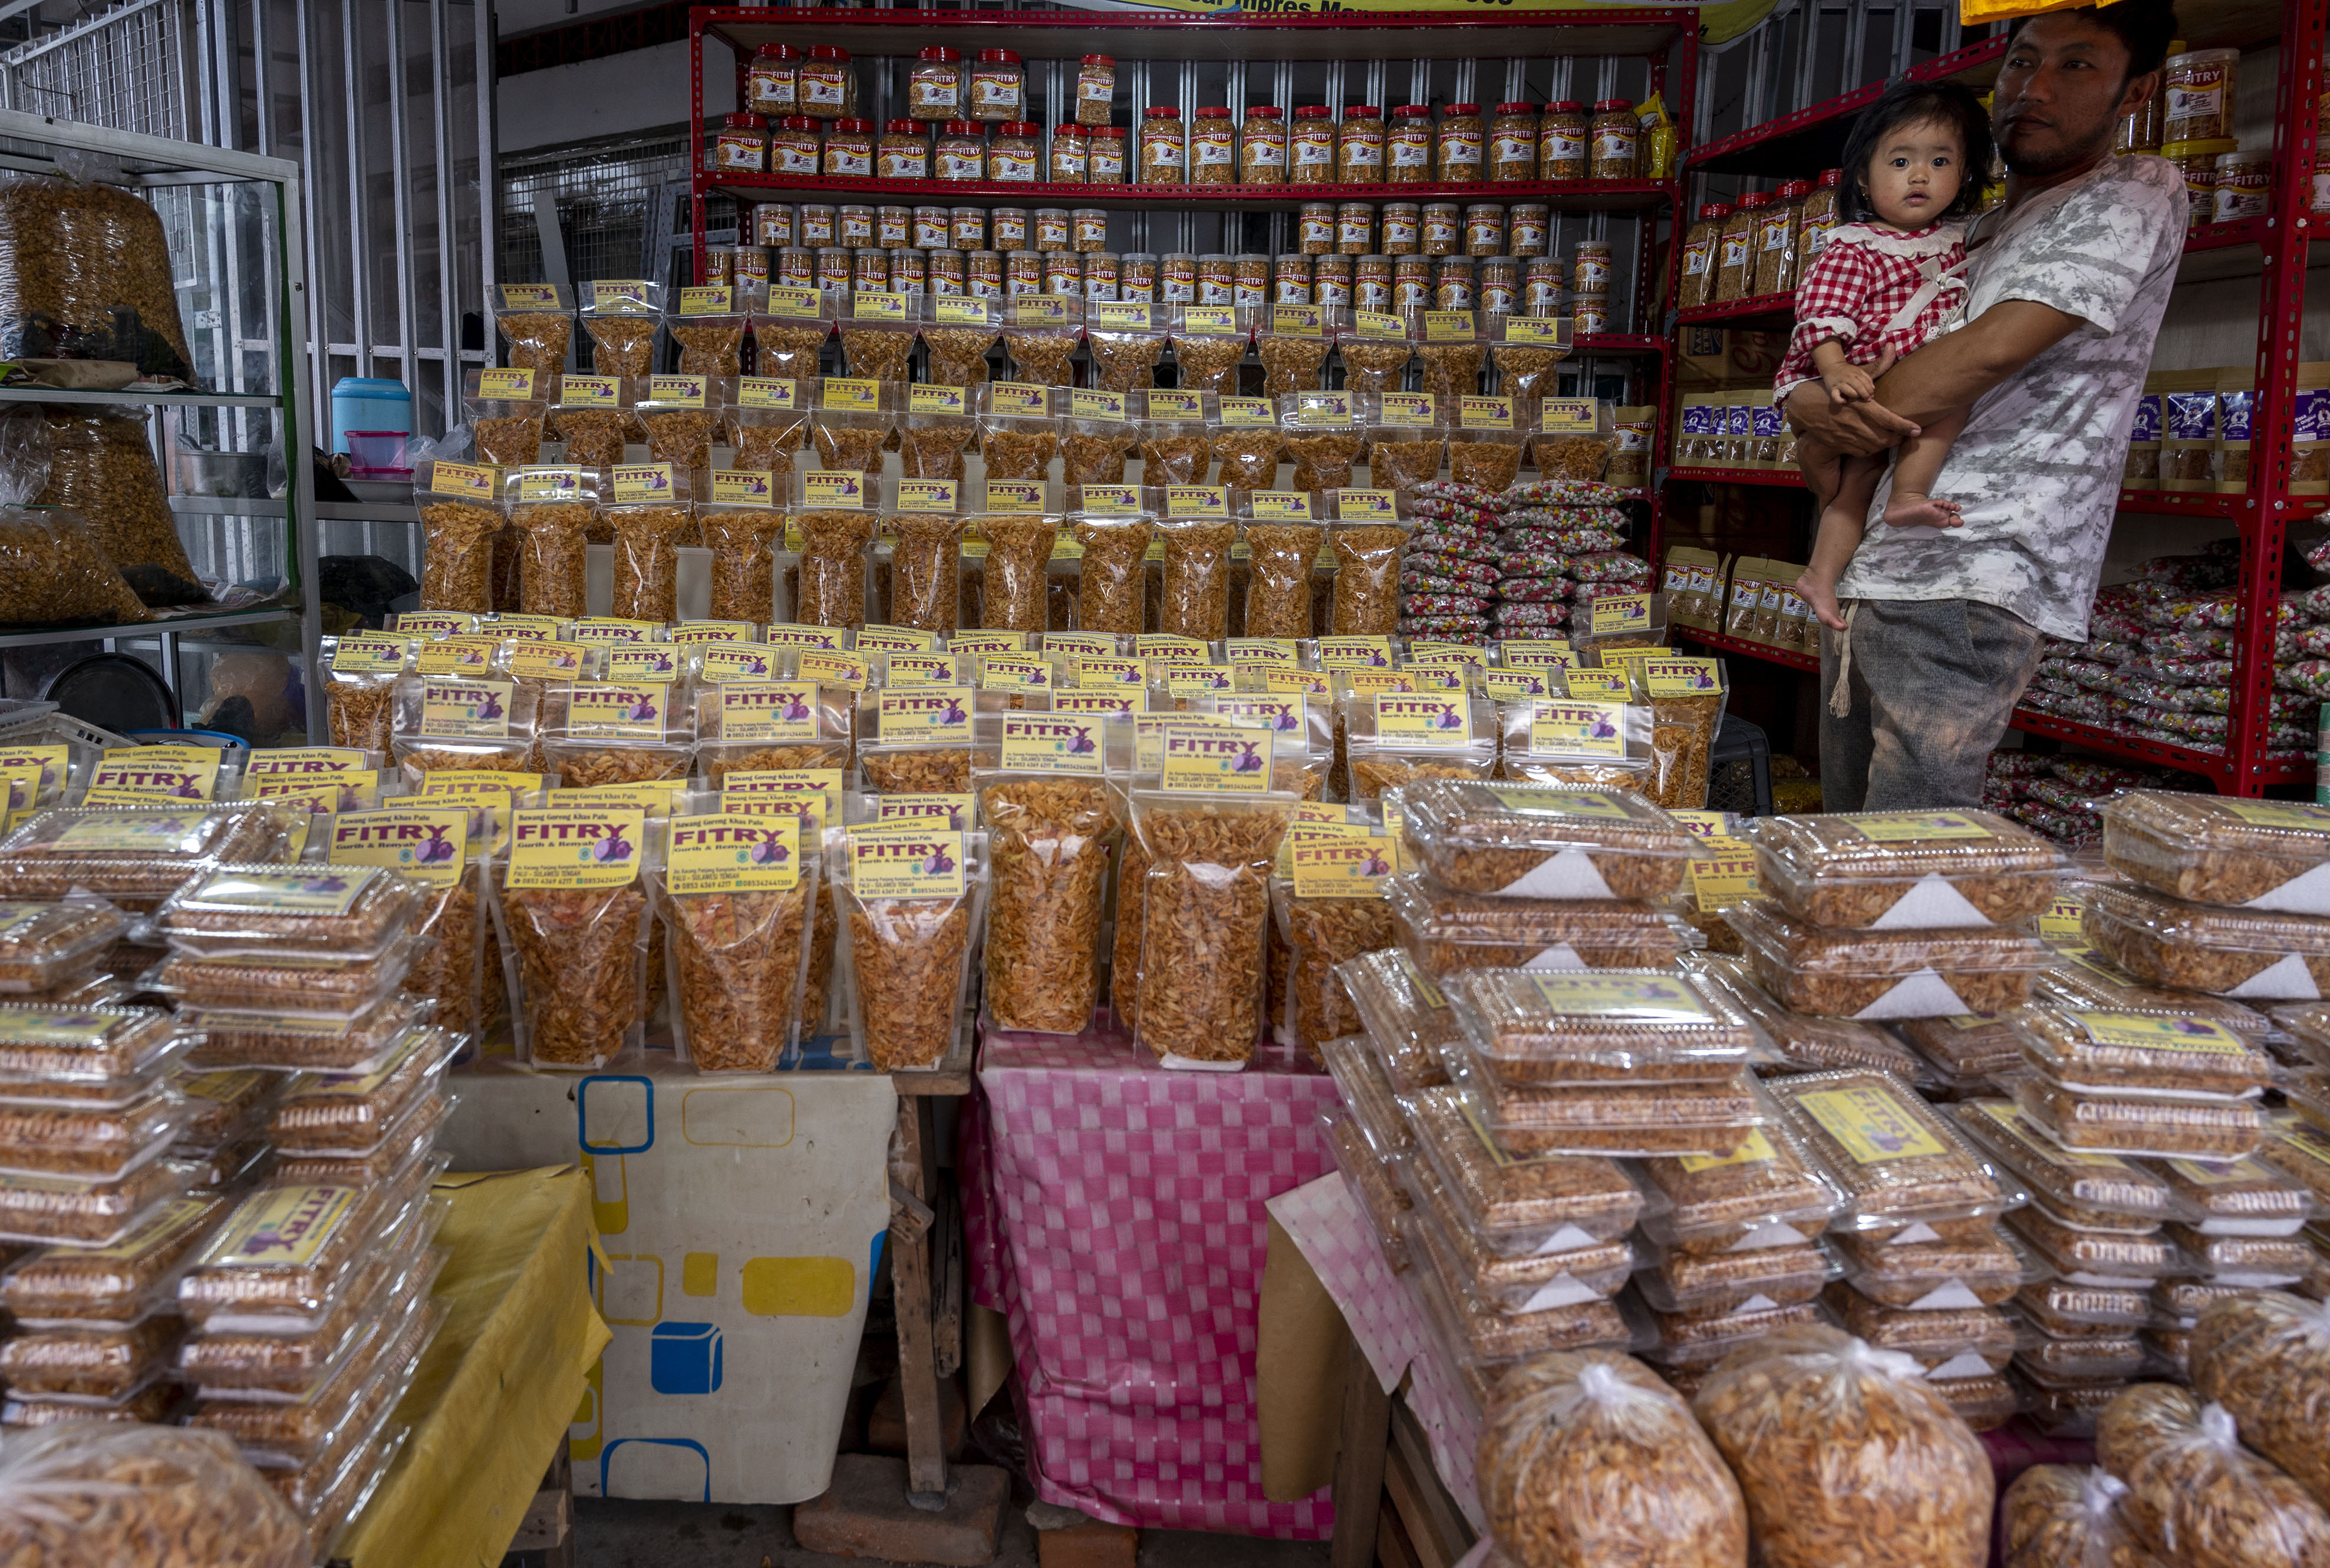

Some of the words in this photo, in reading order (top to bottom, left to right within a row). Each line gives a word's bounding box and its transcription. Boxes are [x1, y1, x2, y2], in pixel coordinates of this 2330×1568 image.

[2184, 71, 2220, 82] FITRY
[2235, 175, 2270, 186] FITRY
[1776, 213, 1788, 222] FITRY
[995, 388, 1039, 397] FITRY
[615, 471, 664, 480] FITRY
[1596, 601, 1642, 610] FITRY
[400, 621, 461, 629] FITRY
[1649, 666, 1710, 675] FITRY
[427, 689, 502, 702] FITRY
[574, 692, 655, 704] FITRY
[725, 693, 806, 705] FITRY
[883, 698, 963, 710] FITRY
[1380, 703, 1456, 712] FITRY
[1535, 709, 1612, 721] FITRY
[1007, 724, 1092, 737] FITRY
[1169, 739, 1260, 752] FITRY
[97, 773, 202, 787] FITRY
[337, 825, 452, 841] FITRY
[518, 824, 630, 840] FITRY
[675, 828, 785, 845] FITRY
[858, 844, 950, 857] FITRY
[1296, 849, 1383, 861] FITRY
[1694, 861, 1755, 874] FITR
